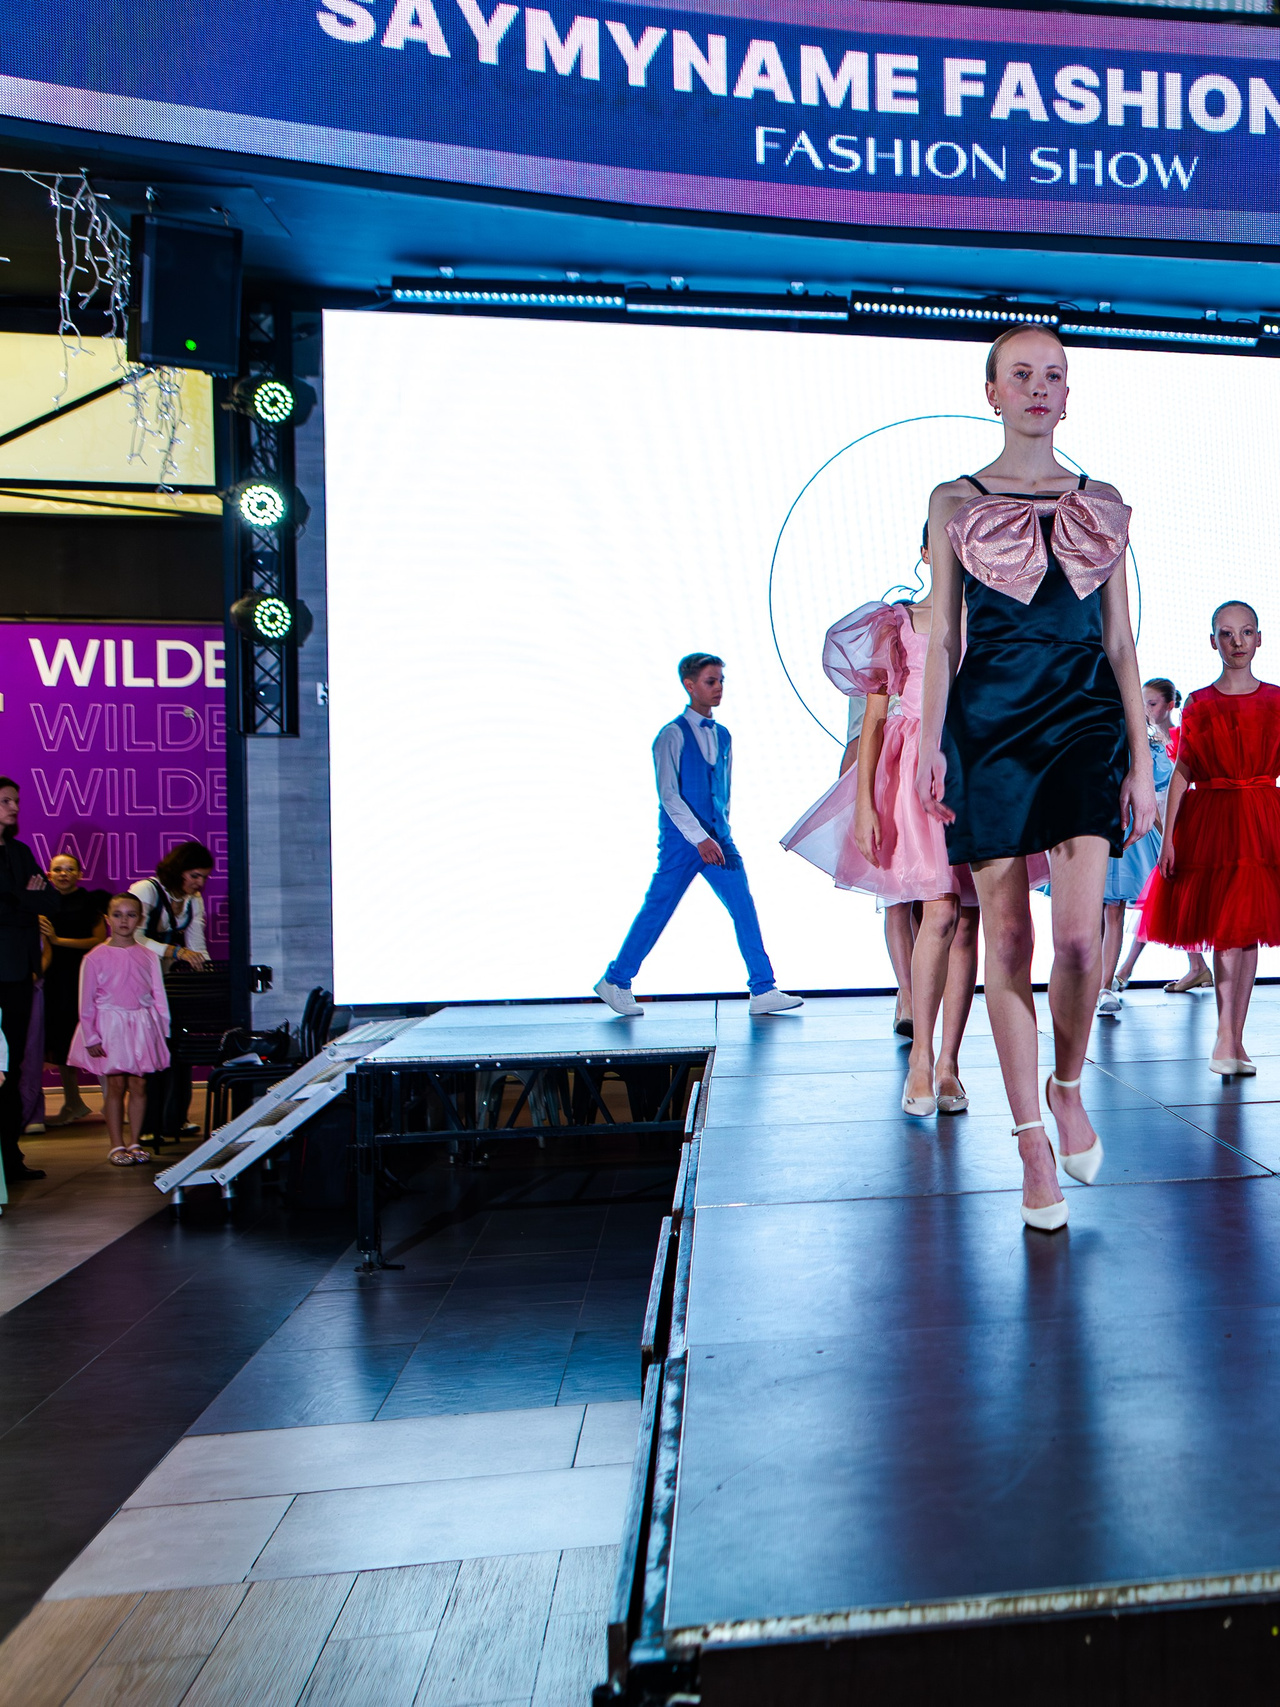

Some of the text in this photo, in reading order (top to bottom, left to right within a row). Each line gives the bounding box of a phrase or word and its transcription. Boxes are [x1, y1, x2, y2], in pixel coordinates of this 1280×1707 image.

[315, 0, 919, 114] SAYMYNAME
[755, 127, 1199, 190] FASHION SHOW
